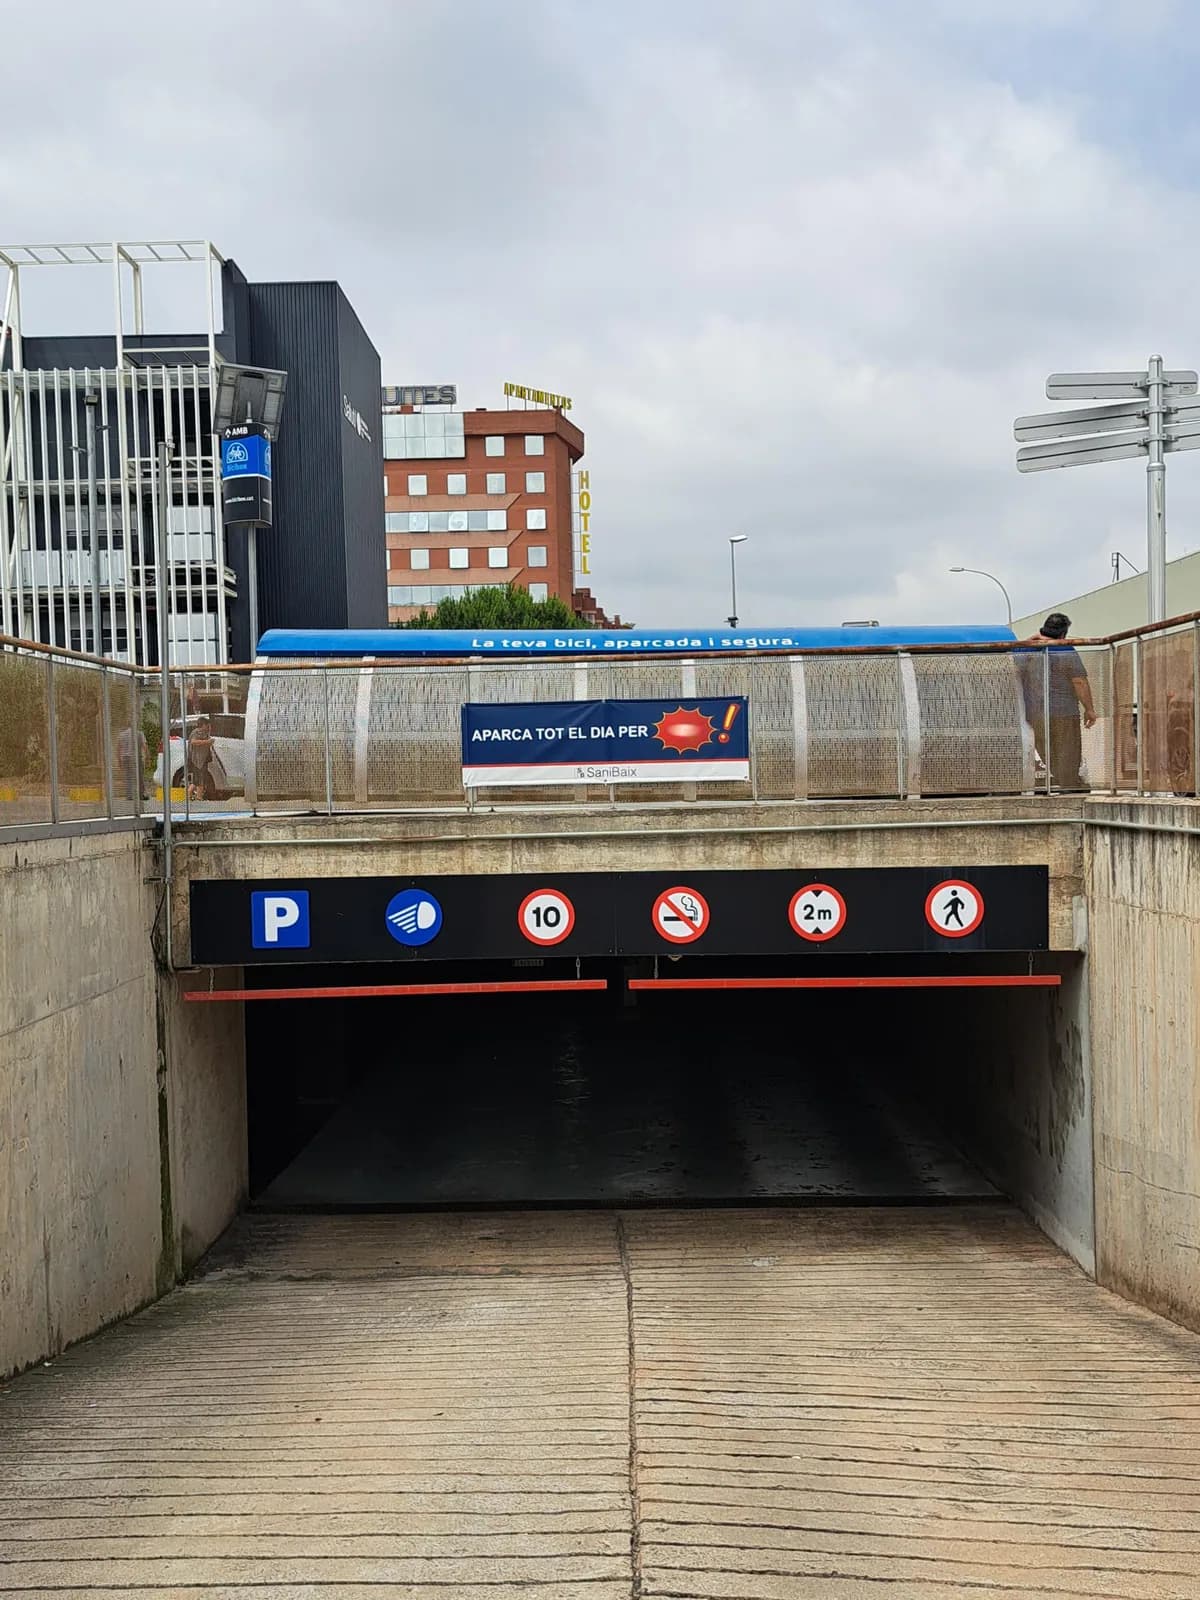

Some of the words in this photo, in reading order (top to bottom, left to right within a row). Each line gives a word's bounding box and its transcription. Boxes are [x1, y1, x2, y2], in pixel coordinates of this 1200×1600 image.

[232, 426, 248, 436] AMB
[579, 471, 592, 575] HOTEL
[472, 639, 494, 649] La
[502, 639, 547, 649] teva
[554, 638, 597, 650] bici,
[604, 638, 702, 650] aparcada
[709, 637, 714, 646] i
[721, 637, 800, 650] segura.
[471, 728, 533, 742] APARCA
[536, 728, 565, 740] TOT
[569, 727, 587, 739] EL
[590, 727, 616, 739] DIA
[618, 725, 649, 738] PER
[587, 766, 637, 779] SaniBaix
[265, 897, 299, 942] P
[532, 906, 561, 928] 10
[803, 904, 833, 921] 2m
